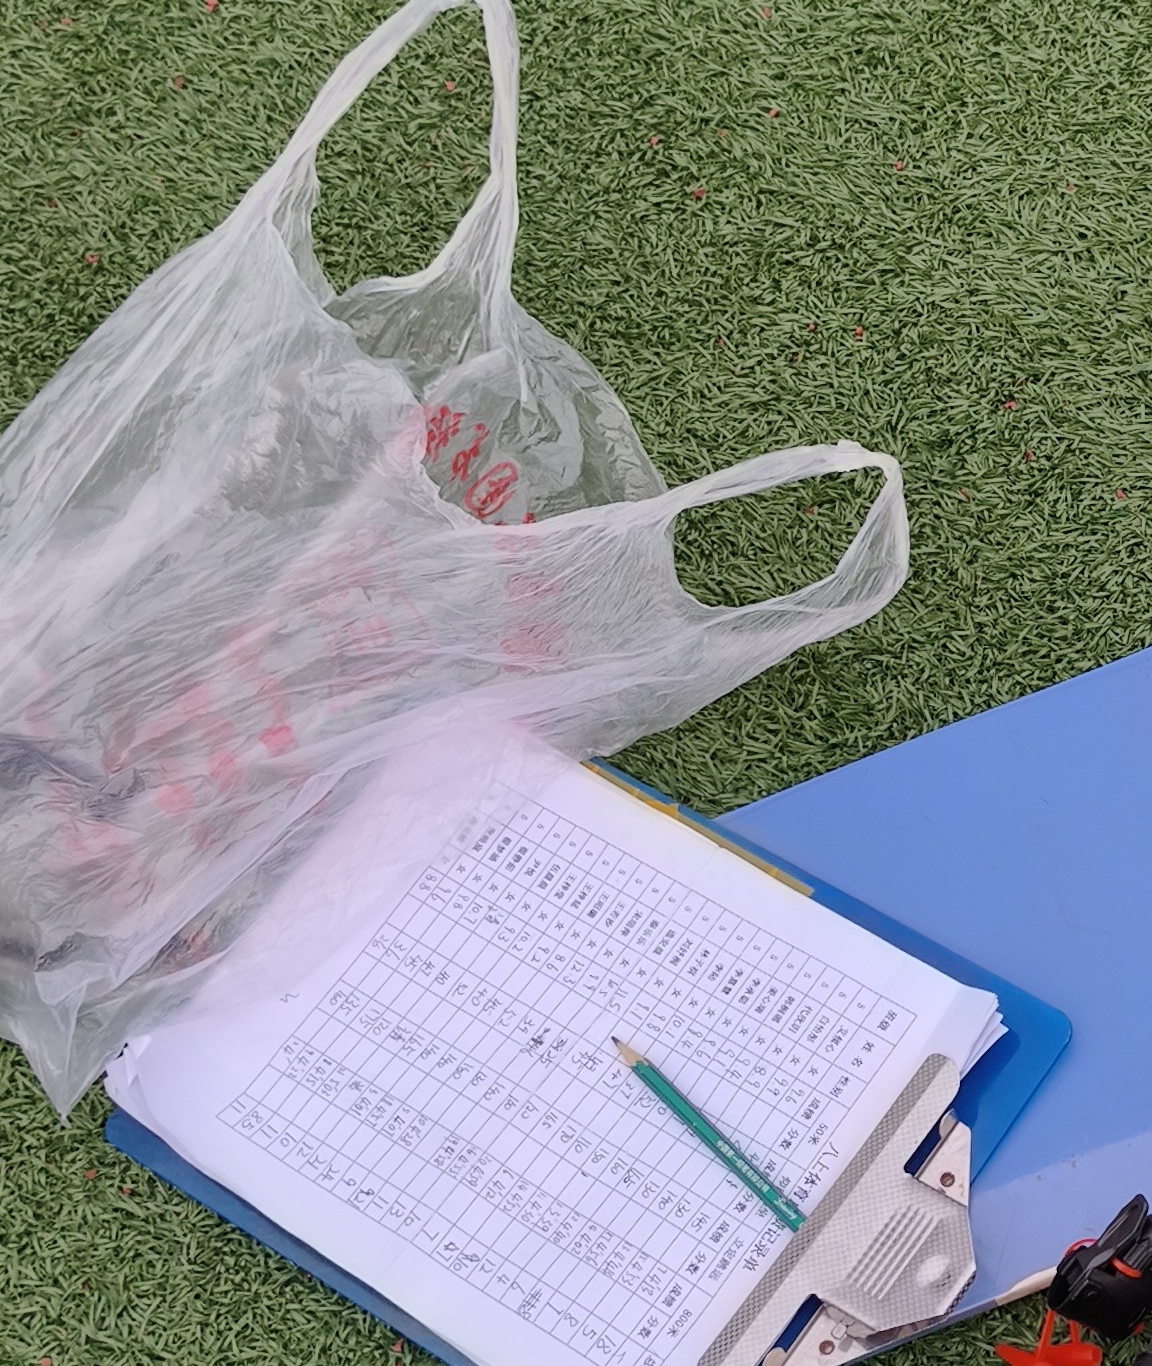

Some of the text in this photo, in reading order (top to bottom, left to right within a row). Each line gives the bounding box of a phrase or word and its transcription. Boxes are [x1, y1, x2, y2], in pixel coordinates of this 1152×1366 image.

[455, 863, 467, 874] 女
[471, 872, 483, 884] 女
[488, 882, 499, 893] 女
[504, 891, 516, 903] 女
[520, 900, 532, 912] 女
[537, 910, 548, 922] 女
[554, 920, 565, 931] 女
[570, 929, 581, 940] 女
[382, 939, 408, 961] 36
[586, 939, 597, 950] 女
[602, 947, 614, 959] 女
[418, 959, 436, 976] 47
[619, 957, 631, 968] 女
[635, 967, 647, 978] 女
[653, 976, 665, 988] 女
[329, 989, 348, 1006] 160
[470, 987, 488, 1006] 40
[670, 987, 682, 999] 女
[687, 996, 699, 1008] 女
[336, 992, 361, 1017] 135
[704, 1006, 716, 1019] 女
[359, 1008, 382, 1030] 175
[372, 1017, 392, 1036] 120
[721, 1016, 733, 1028] 女
[876, 1008, 898, 1032] 班级
[737, 1025, 750, 1037] 女
[398, 1032, 425, 1057] 165
[754, 1035, 766, 1046] 女
[771, 1045, 783, 1056] 女
[296, 969, 451, 1158] 40 12
[435, 1051, 457, 1069] 140
[789, 1055, 801, 1066] 女
[807, 1065, 819, 1077] 女
[481, 1080, 505, 1102] 140
[620, 1081, 634, 1099] 37
[828, 1074, 851, 1098] 性别
[229, 1099, 247, 1113] 11
[499, 1094, 520, 1111] 160
[517, 1101, 540, 1120] 120
[800, 1096, 821, 1120] 成绩
[541, 1111, 559, 1130] 165
[259, 1123, 278, 1139] 11
[559, 1124, 577, 1144] 170
[778, 1127, 800, 1151] 分数
[807, 1122, 829, 1146] 50米
[279, 1132, 299, 1150] 10
[570, 1136, 591, 1154] 110
[590, 1147, 610, 1164] 150
[317, 1162, 340, 1182] 24
[610, 1157, 629, 1176] 160
[340, 1173, 357, 1187] 9
[641, 1180, 660, 1199] 130
[370, 1194, 388, 1210] 11
[658, 1189, 676, 1211] 140
[674, 1197, 691, 1219] 130
[732, 1191, 754, 1214] 分数
[742, 1141, 840, 1272] 八上体育记录单
[386, 1200, 407, 1219] 13
[401, 1209, 422, 1227] 10
[690, 1211, 709, 1232] 145
[418, 1223, 439, 1241] 7
[708, 1219, 731, 1244] 成绩
[478, 1257, 496, 1274] 12
[684, 1250, 707, 1276] 分数
[707, 1236, 744, 1281] 立定跳远
[496, 1273, 511, 1285] 4
[508, 1279, 526, 1296] 6
[661, 1282, 683, 1308] 成绩
[544, 1300, 563, 1315] 7
[563, 1312, 579, 1328] 8
[636, 1314, 659, 1340] 分数
[665, 1308, 692, 1338] 800米
[581, 1324, 598, 1340] 5
[595, 1334, 617, 1355] 18
